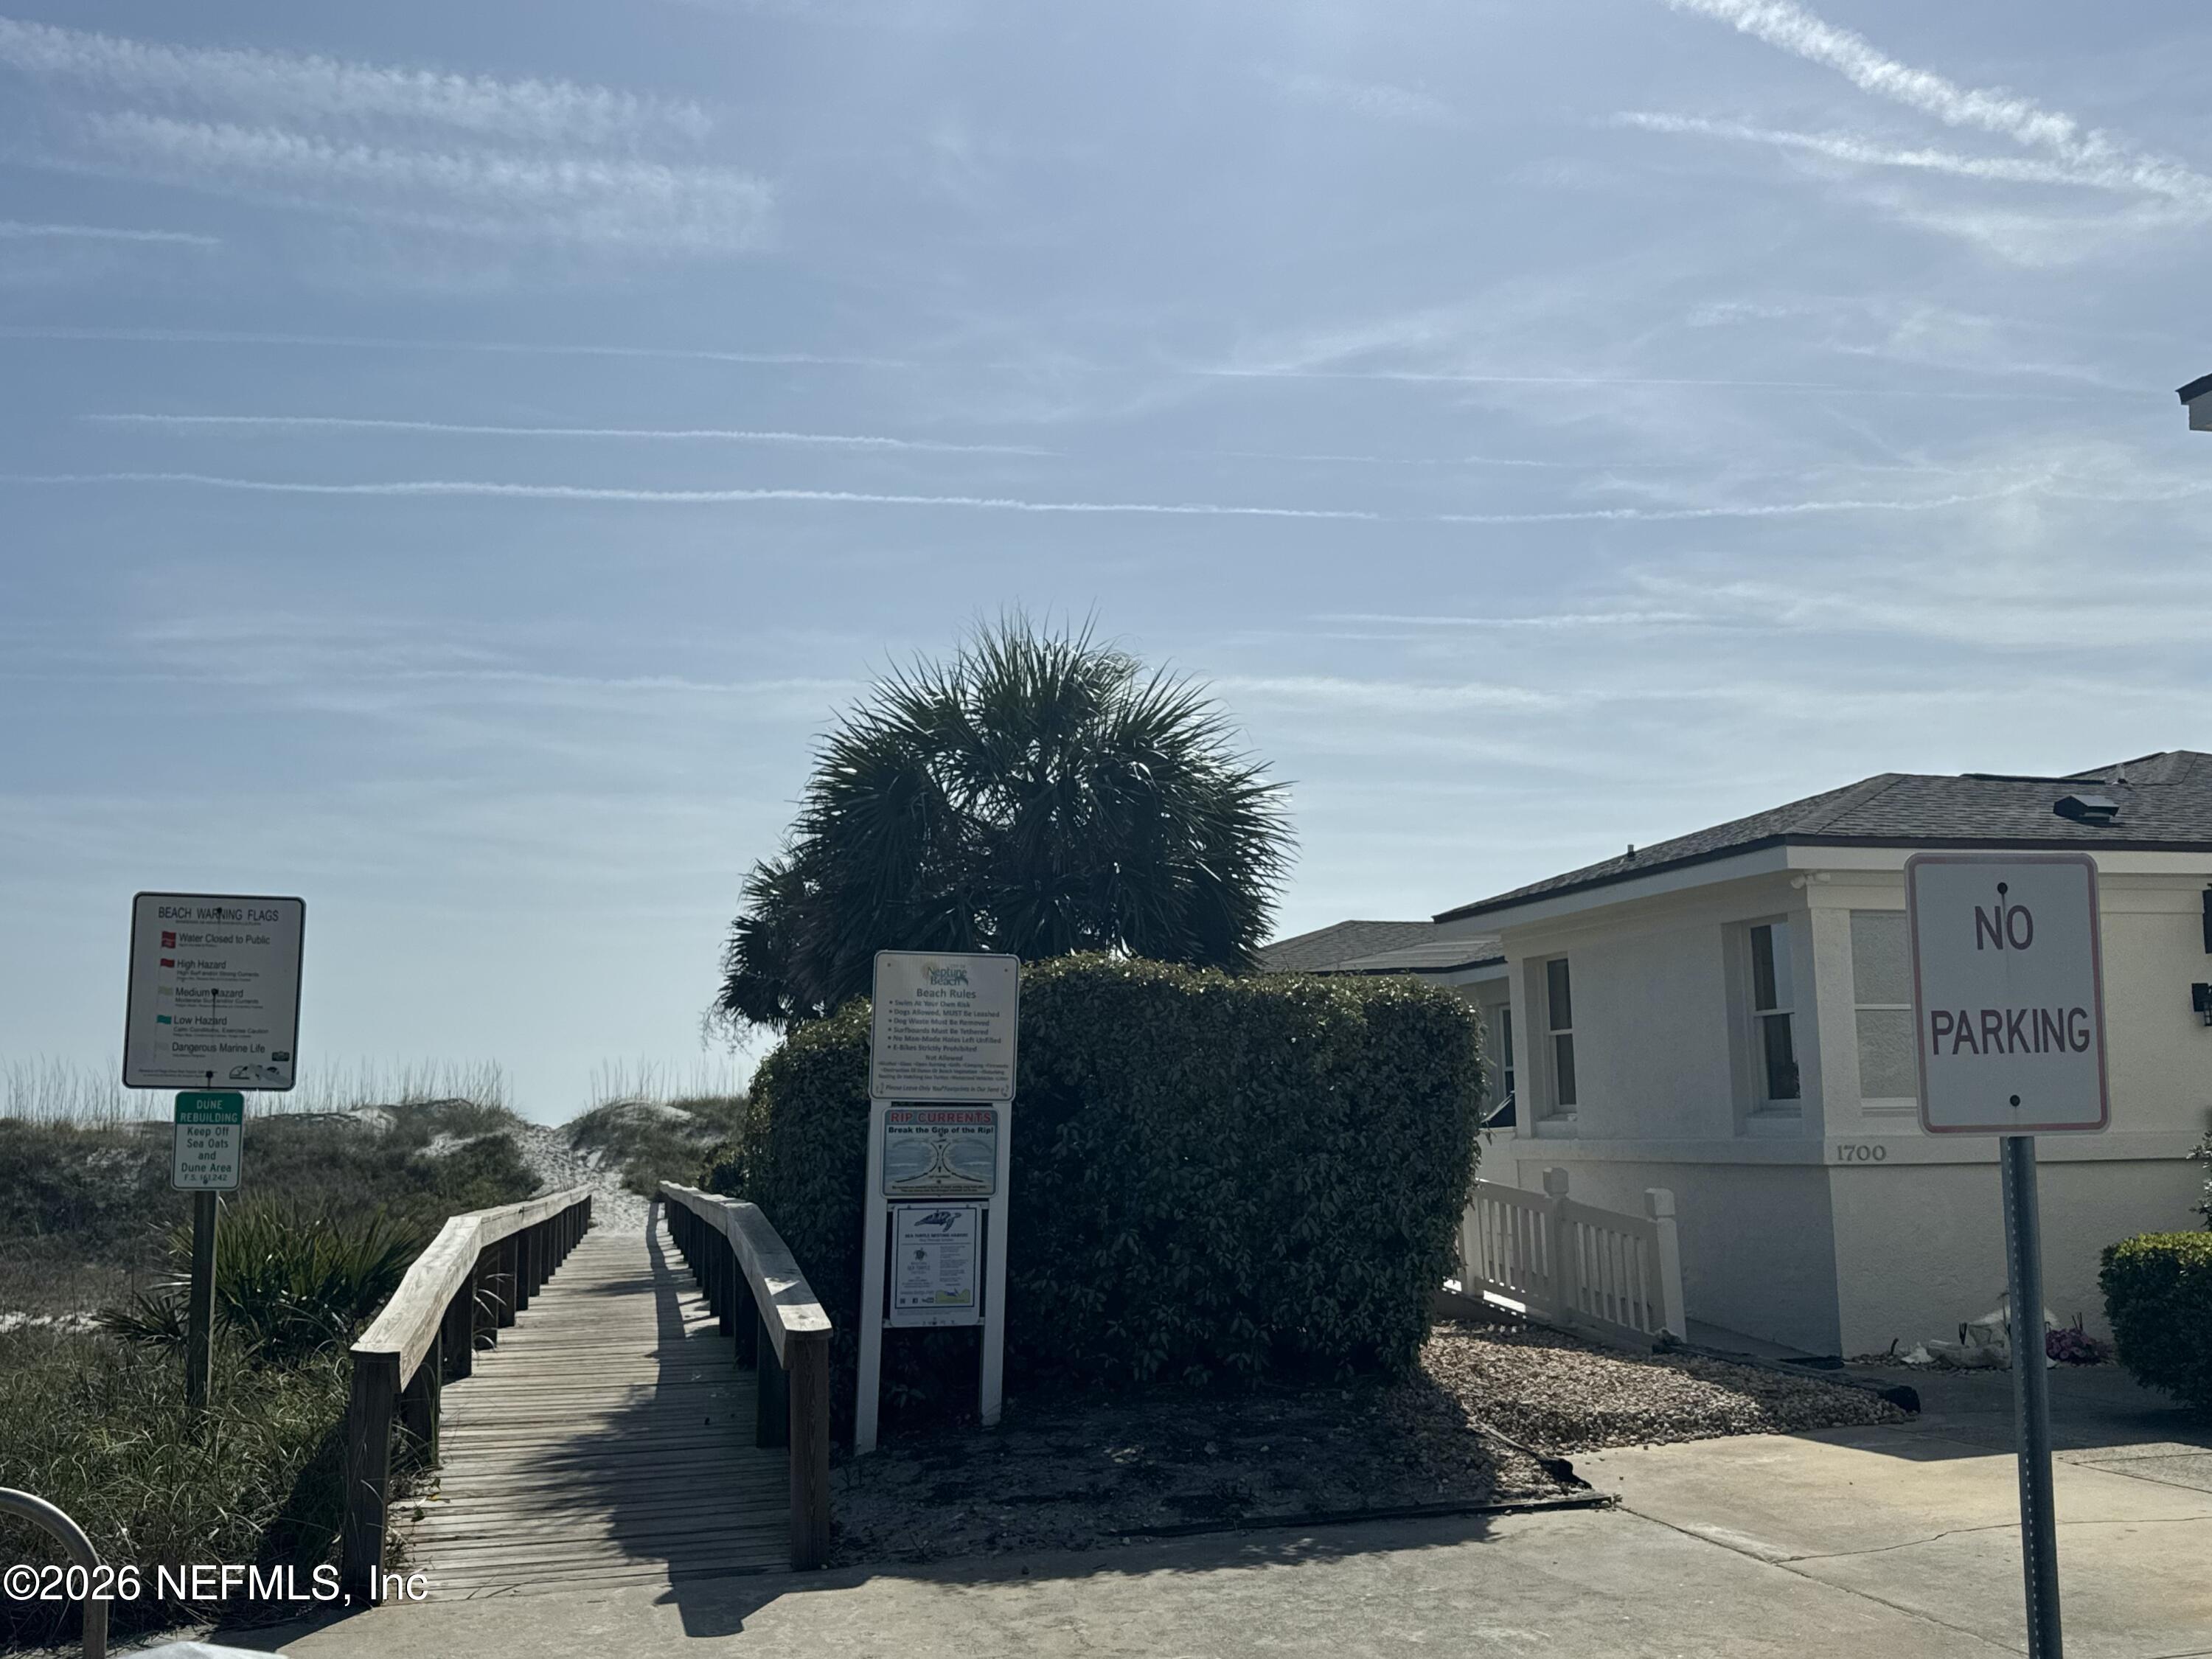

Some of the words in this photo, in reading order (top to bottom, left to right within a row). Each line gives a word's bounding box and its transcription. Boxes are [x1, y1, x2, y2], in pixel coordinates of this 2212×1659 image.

[159, 906, 192, 919] BEACH
[197, 908, 243, 920] WARNING
[248, 908, 279, 922] FLAGS
[1975, 905, 2034, 950] NO
[179, 933, 204, 943] Water
[205, 933, 234, 944] Closed
[235, 934, 243, 944] to
[246, 935, 271, 945] Public
[177, 960, 195, 970] High
[198, 960, 226, 970] Hazard
[928, 967, 967, 978] Neptune
[931, 976, 961, 986] Beach
[175, 987, 210, 997] Medium
[917, 988, 946, 998] Beach
[950, 990, 976, 999] Rules
[173, 1015, 192, 1025] Low
[195, 1015, 227, 1026] Hazard
[1930, 1007, 2090, 1055] PARKING
[172, 1042, 217, 1054] Dangerous
[219, 1043, 248, 1053] Marine
[250, 1043, 265, 1053] Life
[197, 1099, 223, 1110] DUNE
[180, 1113, 238, 1123] REBUILDING
[890, 1112, 913, 1122] RIP
[918, 1112, 992, 1123] CURRENTS
[187, 1127, 211, 1138] Keep
[215, 1126, 229, 1136] Off
[932, 1126, 949, 1134] Grip
[978, 1127, 994, 1135] Rip!
[187, 1138, 204, 1148] Sea
[208, 1139, 229, 1148] Oats
[198, 1151, 216, 1160] and
[1837, 1144, 1887, 1161] 1700
[181, 1163, 206, 1172] Dune
[210, 1163, 232, 1172] Area
